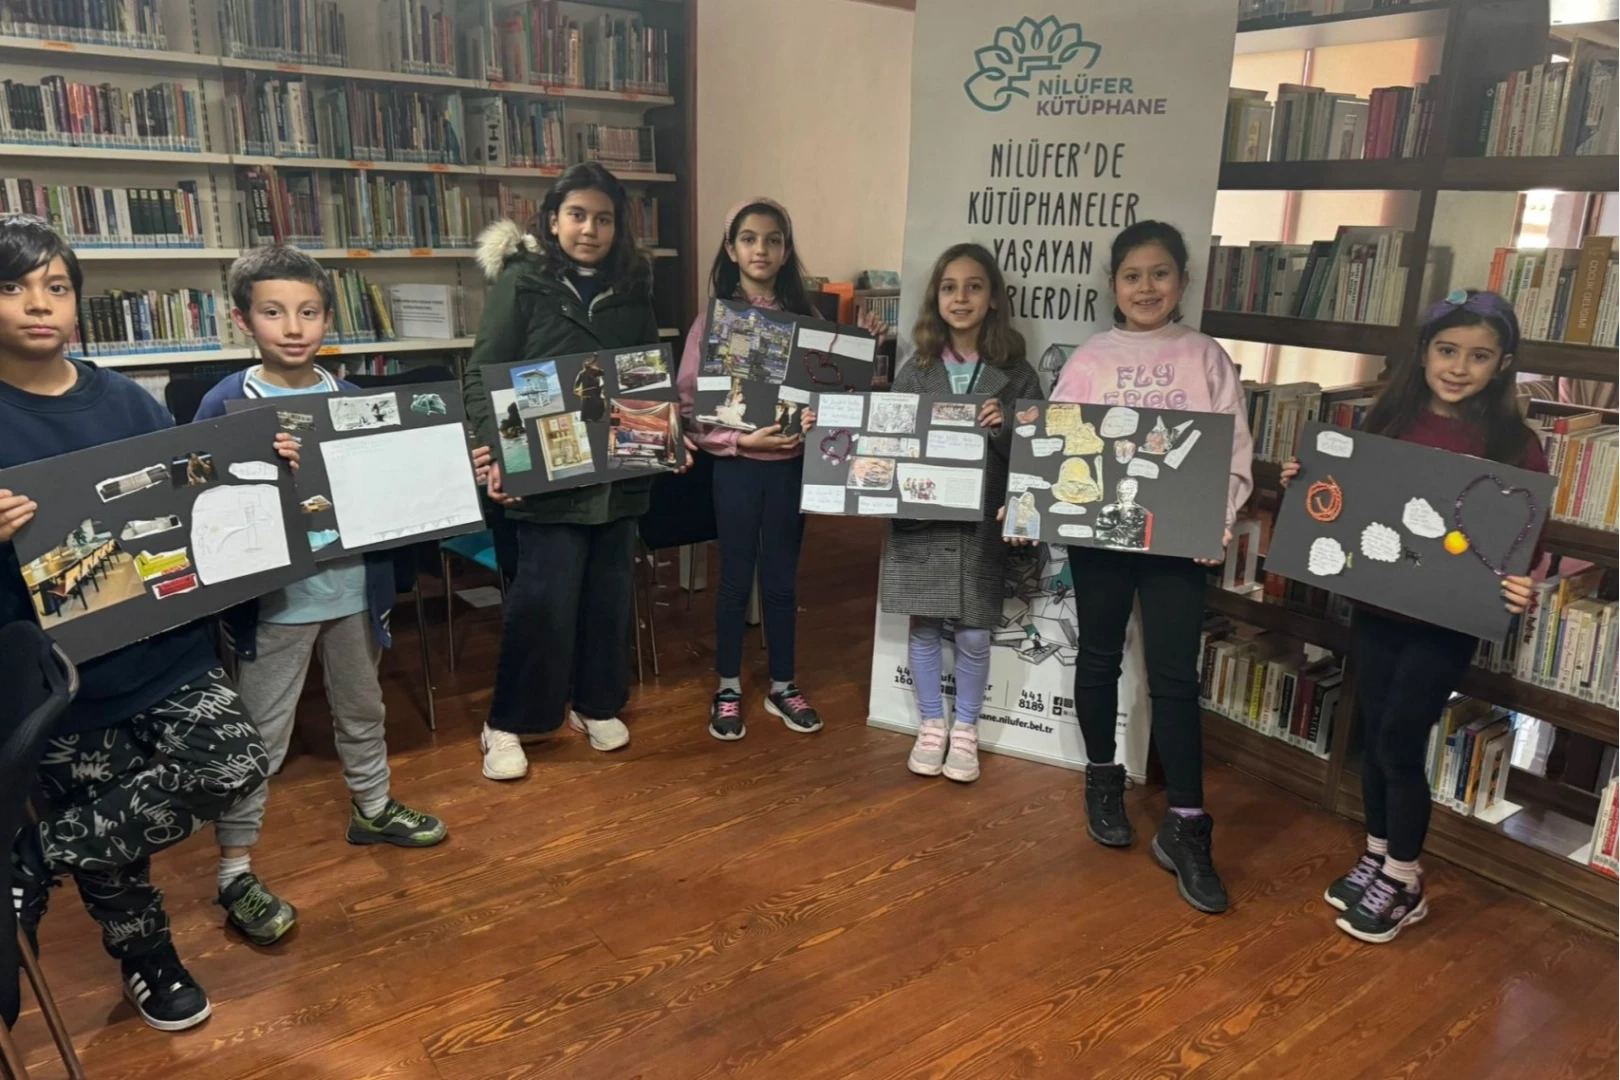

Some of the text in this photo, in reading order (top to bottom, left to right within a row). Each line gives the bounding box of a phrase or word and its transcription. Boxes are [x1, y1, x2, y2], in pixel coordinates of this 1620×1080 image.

[1037, 73, 1134, 96] NİLÜFER
[1035, 95, 1167, 116] KÜTÜPHANE
[990, 138, 1126, 179] NİLÜFER'DE
[967, 187, 1141, 228] KÜTÜPHANELER
[993, 238, 1093, 279] YAŞAYAN
[1005, 283, 1099, 323] RLERDİR
[1116, 363, 1175, 389] FLY
[1018, 698, 1045, 713] 8189
[1021, 689, 1043, 703] 441
